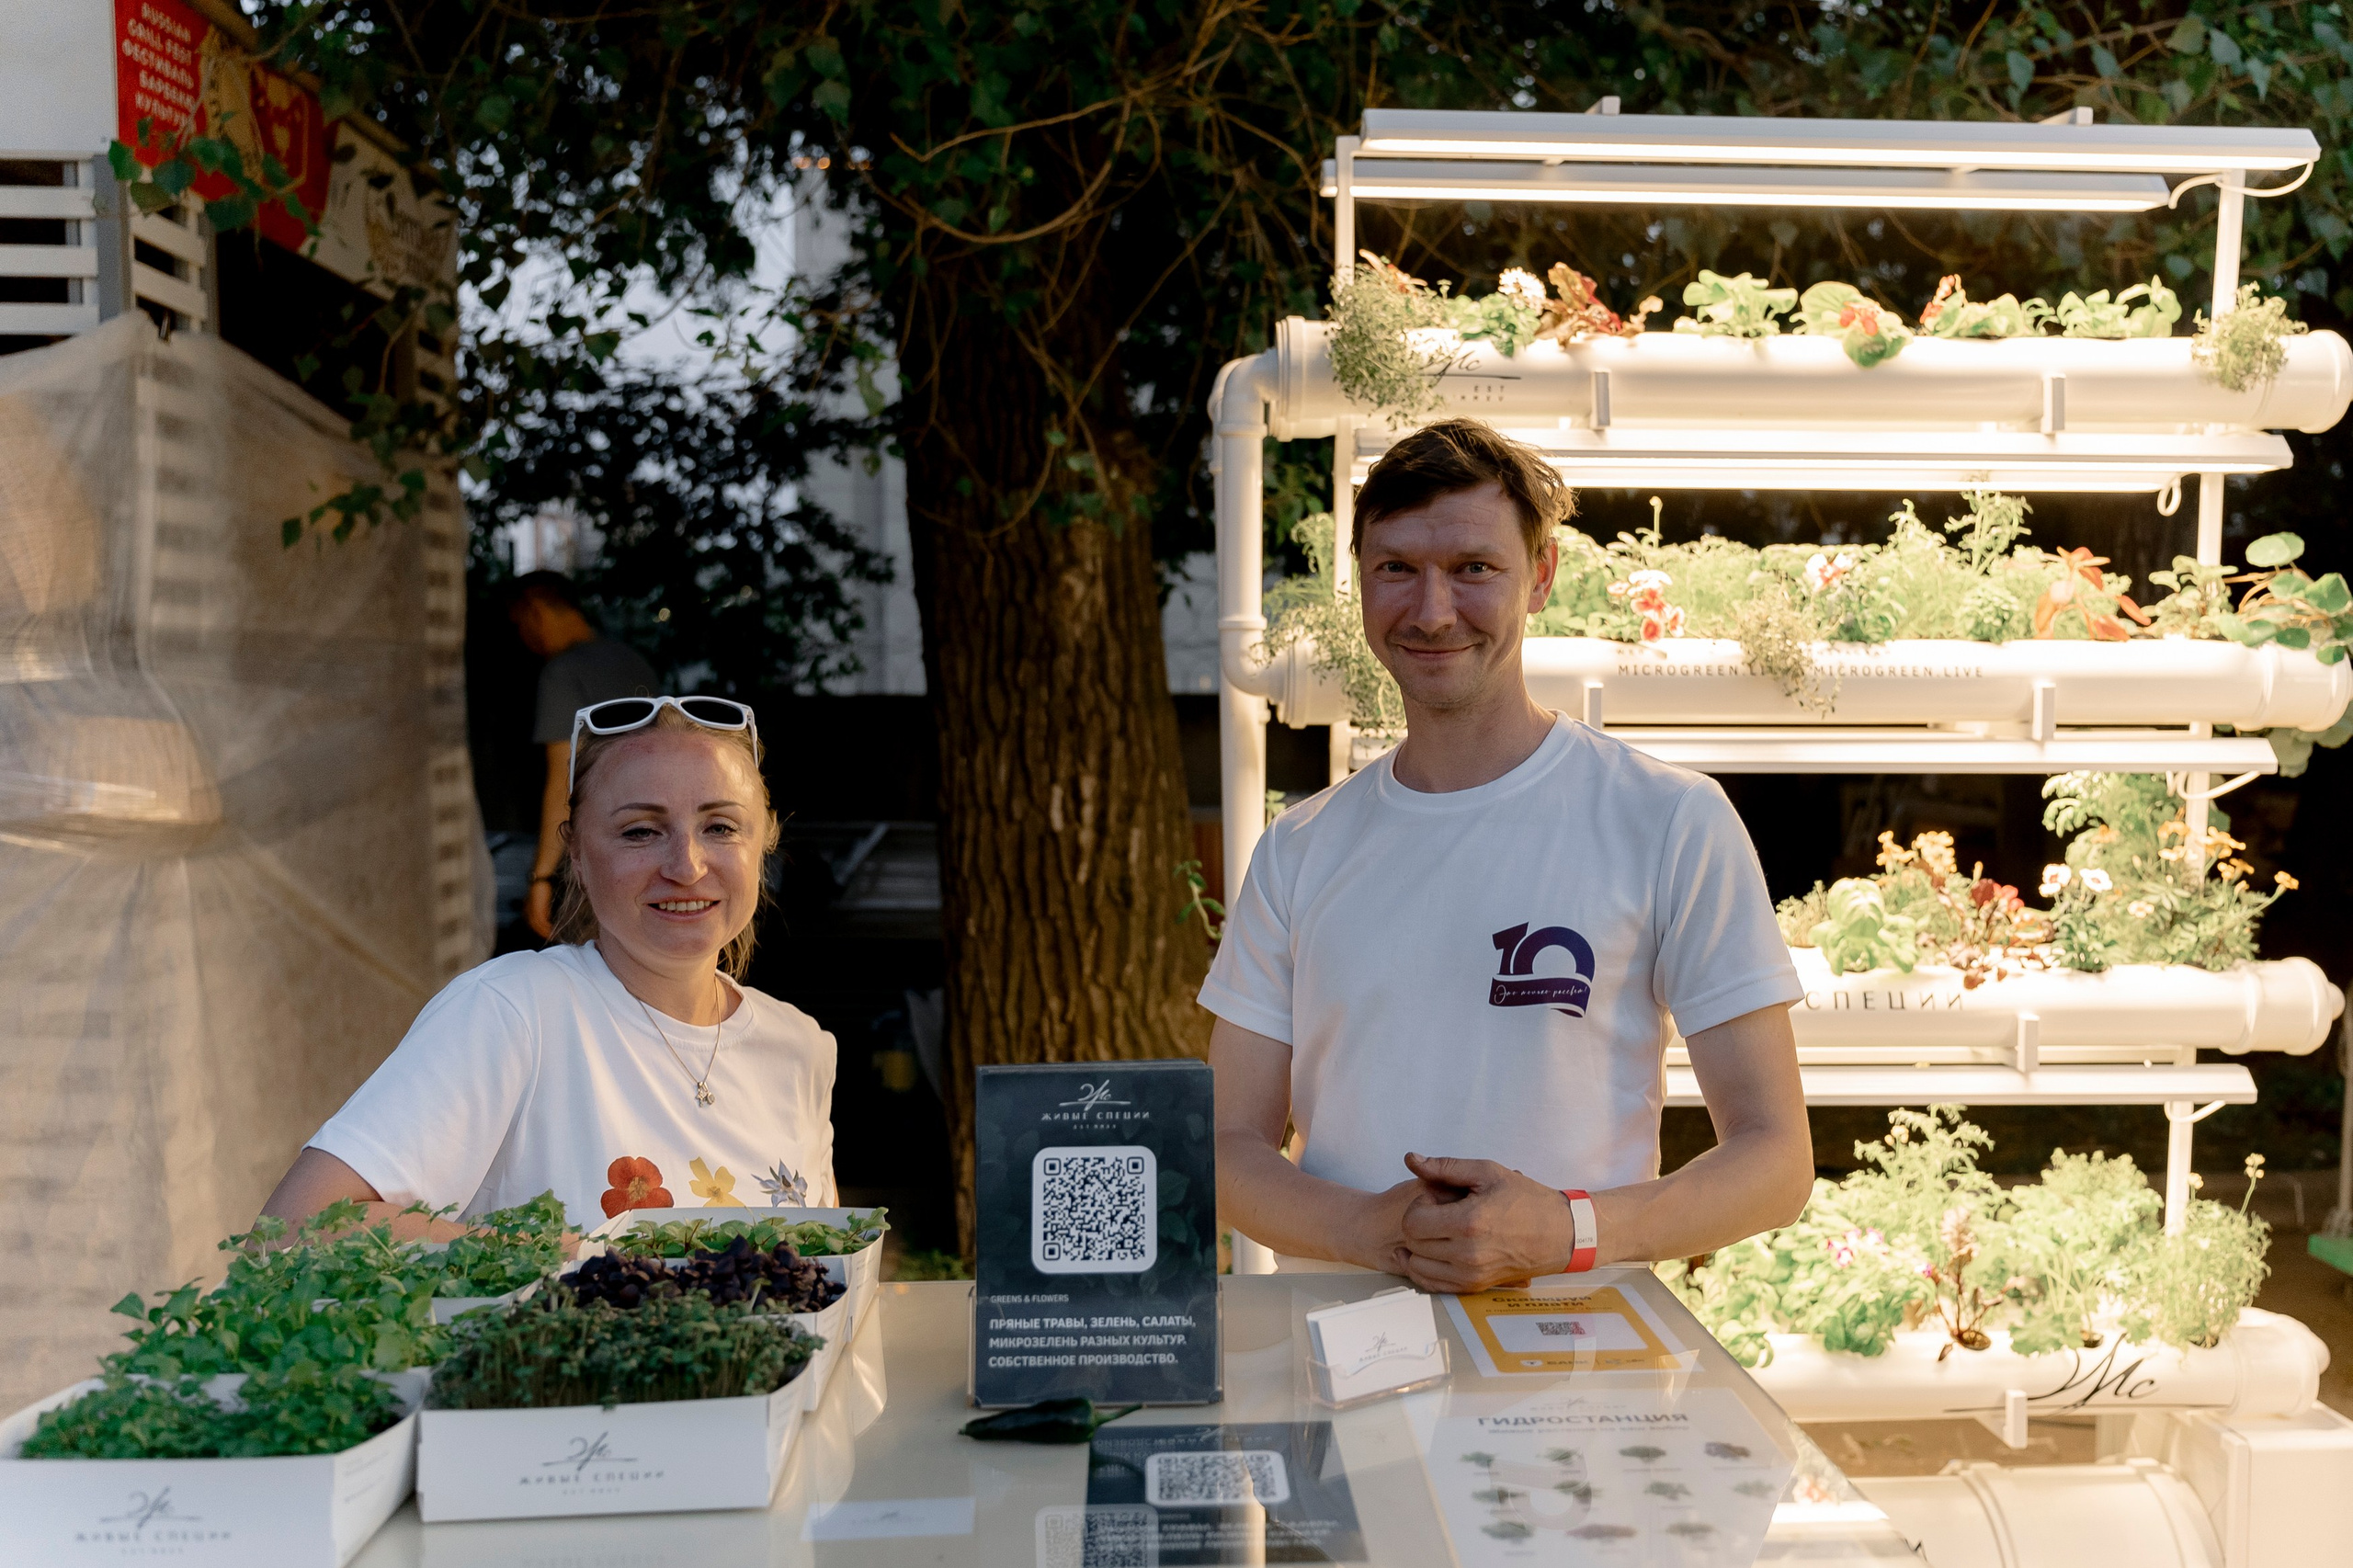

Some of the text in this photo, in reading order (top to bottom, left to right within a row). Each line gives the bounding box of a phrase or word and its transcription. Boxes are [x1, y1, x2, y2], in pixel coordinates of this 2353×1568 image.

[141, 2, 191, 43] RUSSIAN
[127, 17, 192, 65] GRILL FEST
[122, 39, 194, 89] ФЕСТИВАЛЬ
[1804, 991, 1964, 1011] СПЕЦИИ
[1040, 1110, 1150, 1120] ЖИВЫЕ СПЕЦИИ
[990, 1293, 1069, 1303] GREENS & FLOWERS
[989, 1315, 1196, 1330] ПРЯНЫЕ ТРАВЫ, ЗЕЛЕНЬ, САЛАТЫ,
[989, 1335, 1187, 1348] МИКРОЗЕЛЕНЬ РАЗНЫХ КУЛЬТУР.
[988, 1353, 1178, 1368] СОБСТВЕННОЕ ПРОИЗВОДСТВО.
[1478, 1414, 1688, 1426] ГИДРОСТАНЦИЯ
